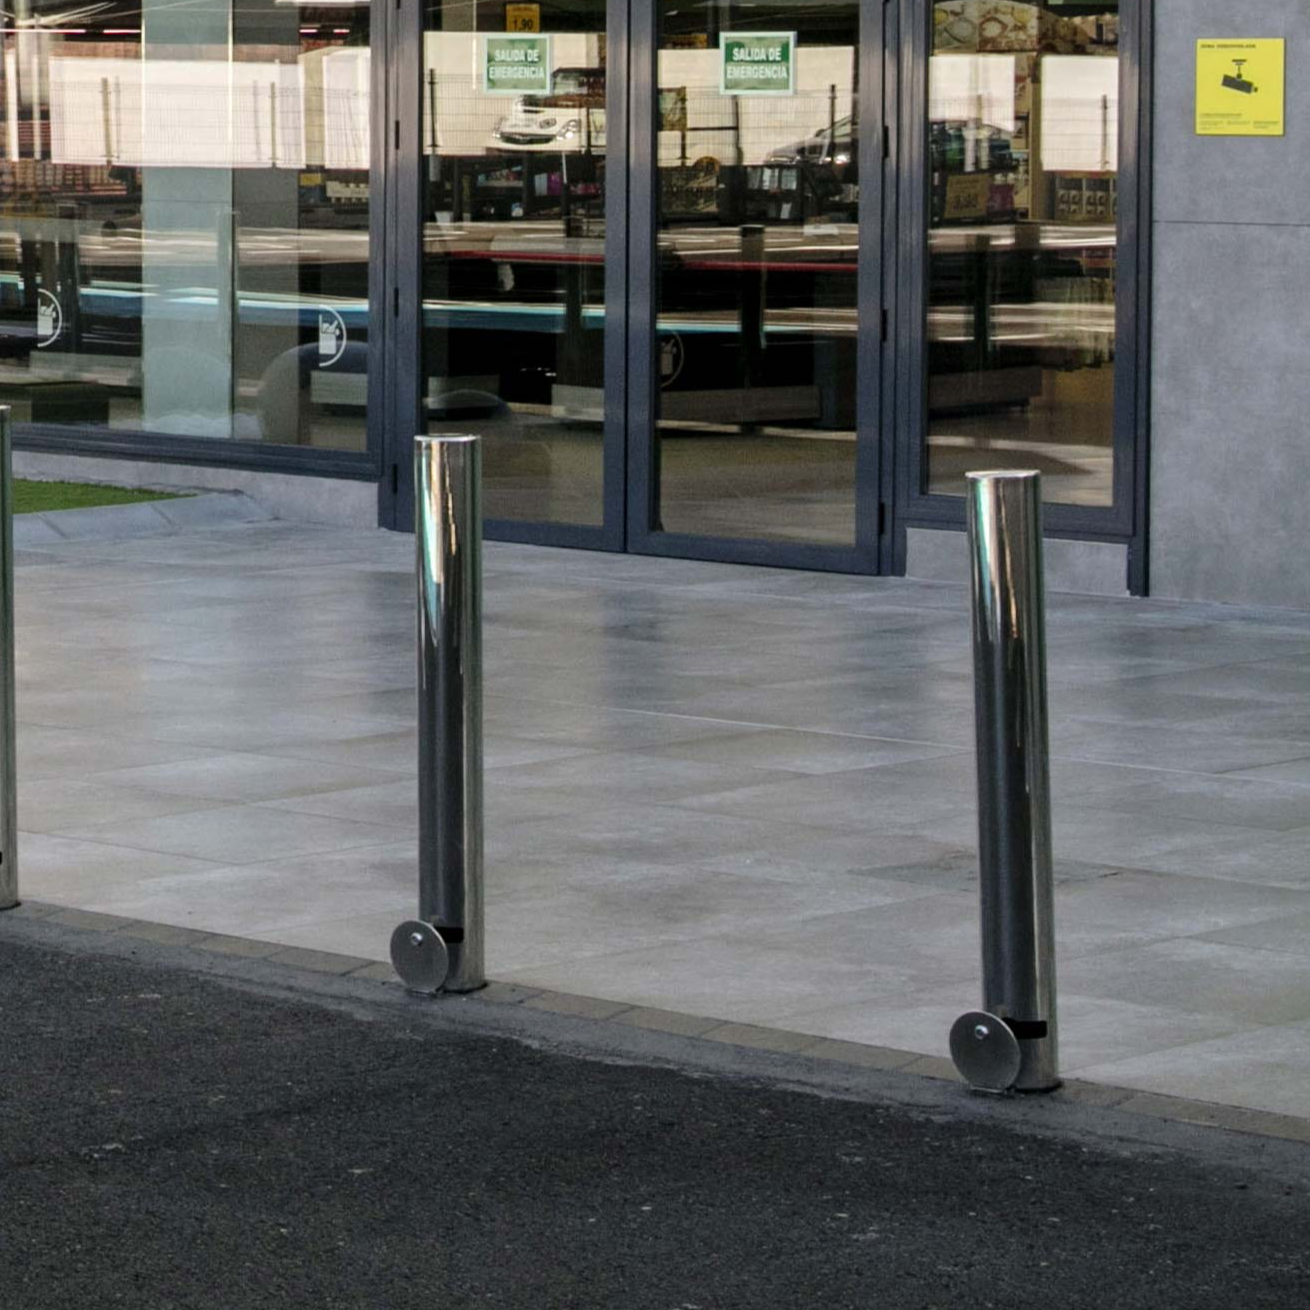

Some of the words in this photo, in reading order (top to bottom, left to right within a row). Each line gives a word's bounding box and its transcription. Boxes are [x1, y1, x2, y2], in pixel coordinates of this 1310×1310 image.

[494, 49, 525, 62] SALIDA
[527, 49, 540, 62] DE
[732, 47, 766, 61] SALIDA
[768, 47, 782, 61] DE
[489, 66, 545, 80] EMERGENCIA
[726, 66, 788, 79] EMERGENCIA
